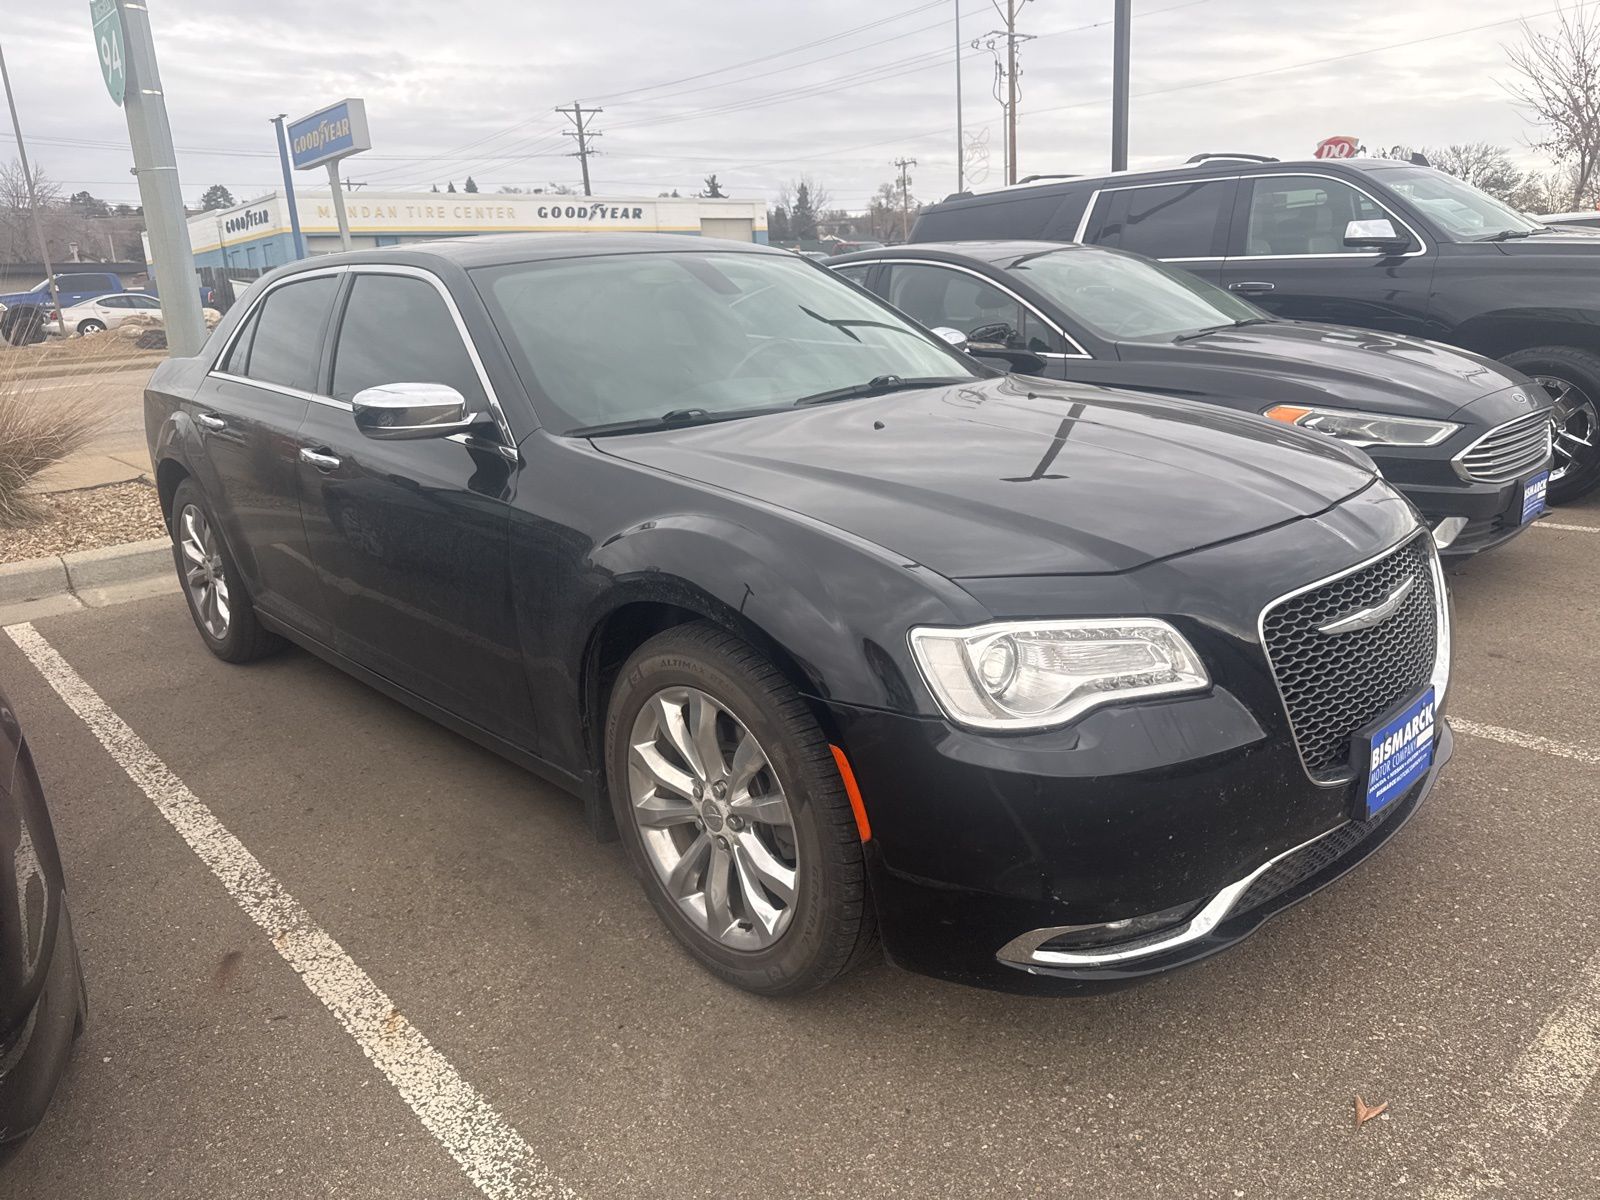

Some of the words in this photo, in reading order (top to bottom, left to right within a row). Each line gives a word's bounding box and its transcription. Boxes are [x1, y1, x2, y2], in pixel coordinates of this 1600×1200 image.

[101, 30, 123, 84] 94
[294, 118, 350, 154] GOODYEAR
[1322, 143, 1350, 158] DQ
[225, 209, 269, 233] GOODYEAR
[317, 206, 398, 218] MNDAN
[406, 206, 446, 218] TIRE
[453, 206, 516, 219] CENTER
[537, 204, 643, 220] GOODYEAR
[661, 660, 704, 674] ALTIMAX
[1371, 702, 1434, 771] BISMARCK
[1370, 760, 1391, 786] MOTOR
[1392, 739, 1417, 768] COMPANY
